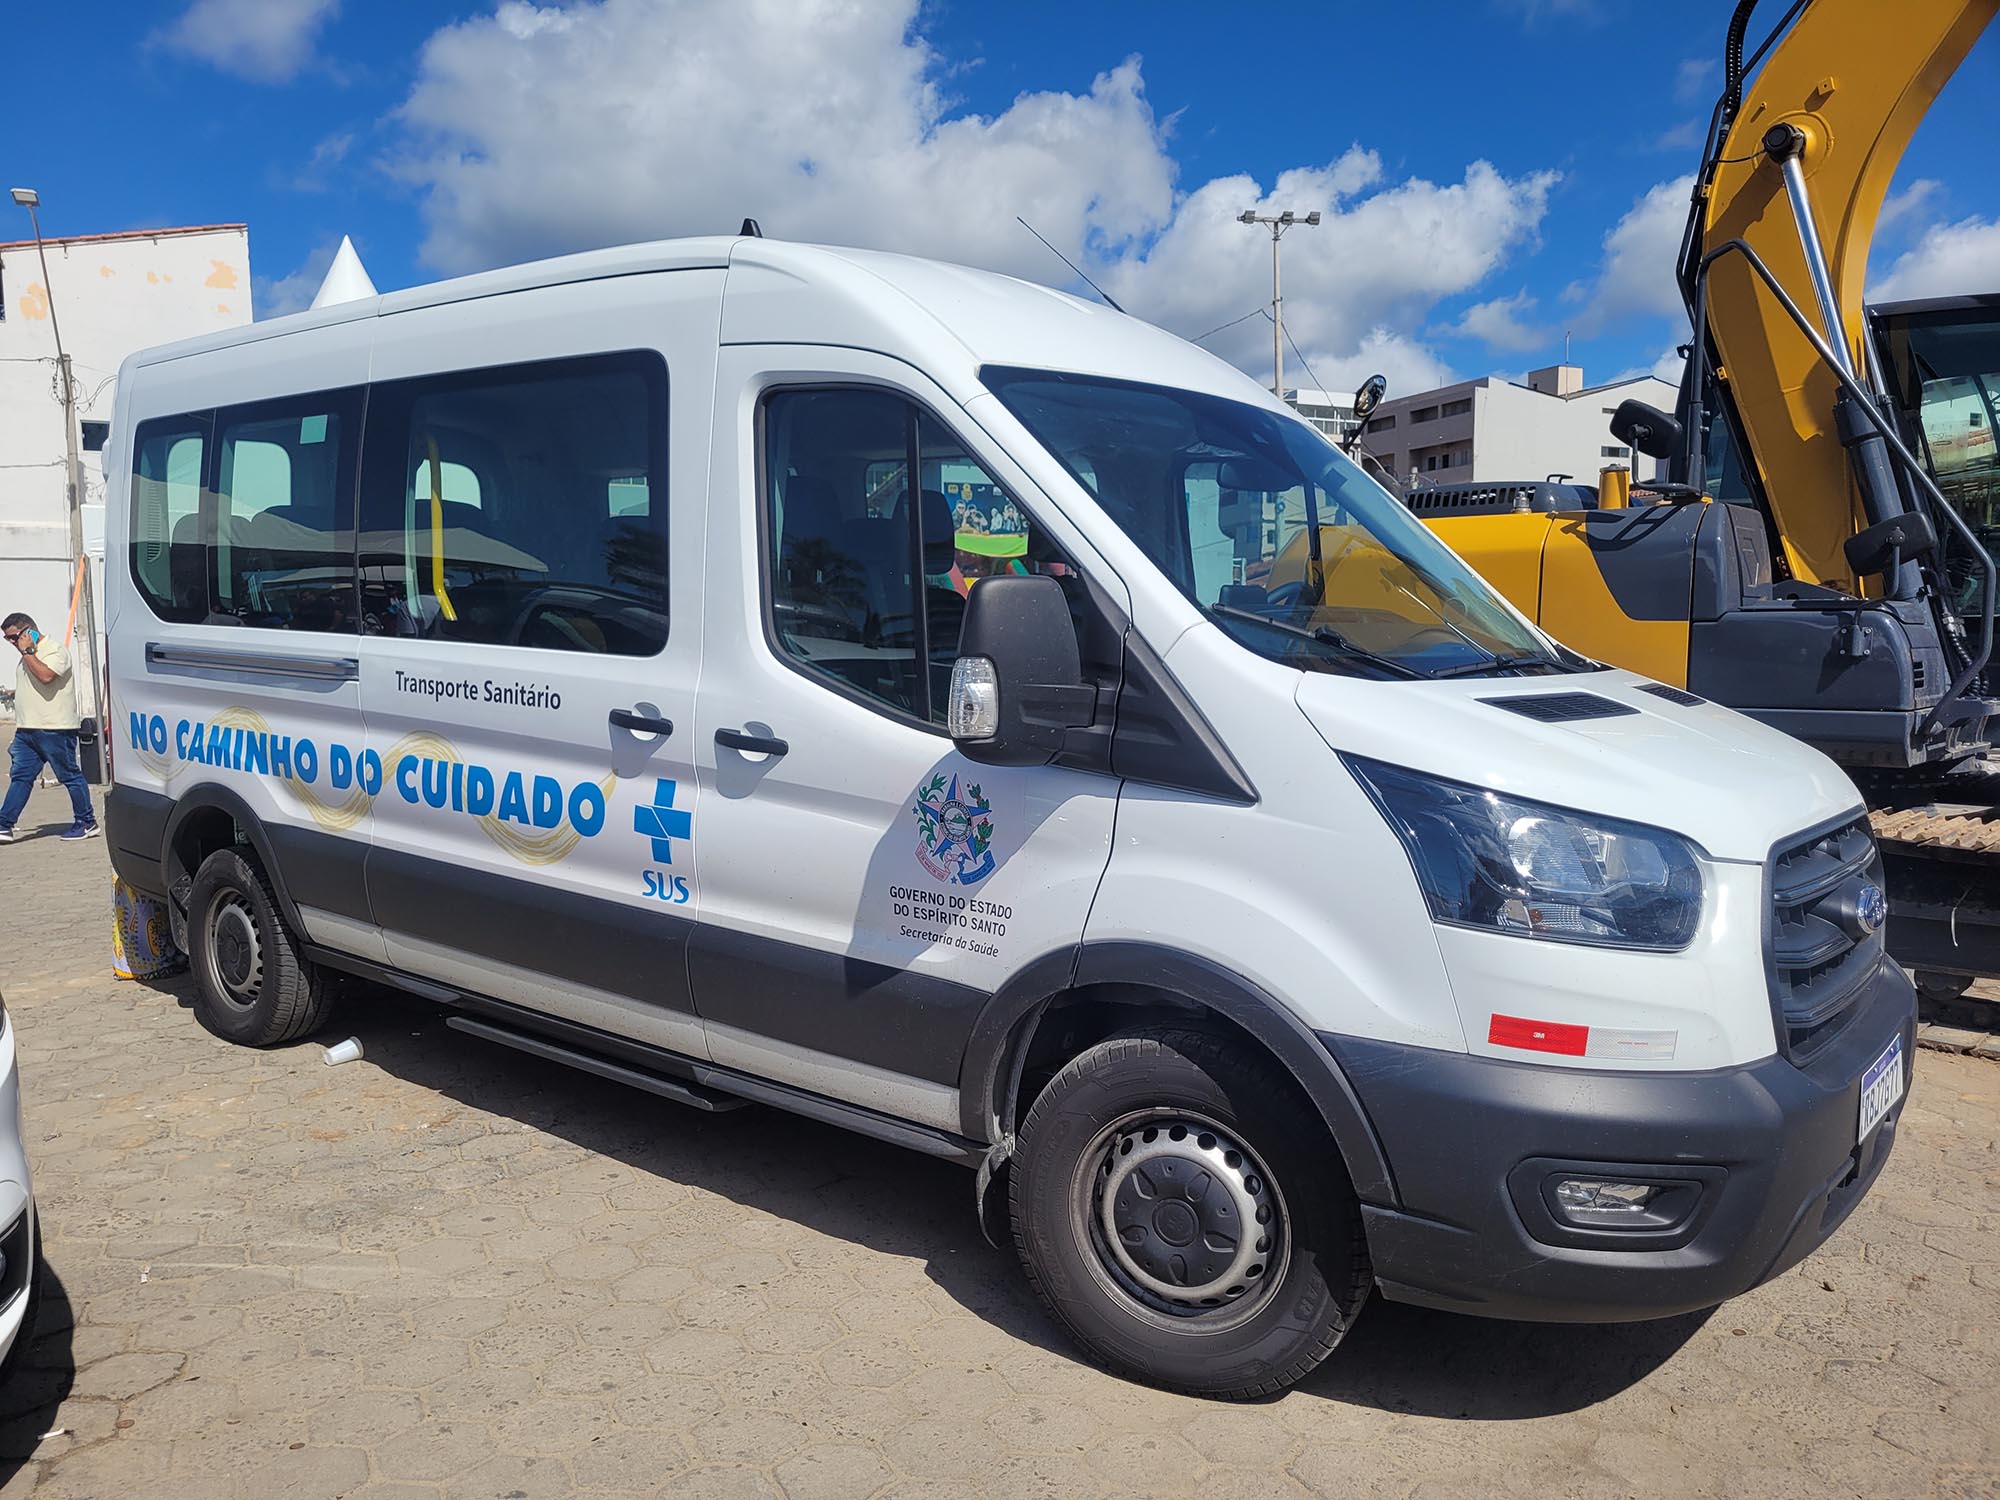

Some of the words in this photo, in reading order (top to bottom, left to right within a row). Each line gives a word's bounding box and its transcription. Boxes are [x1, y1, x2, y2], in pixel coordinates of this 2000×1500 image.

[395, 670, 479, 702] Transporte
[483, 680, 561, 710] Sanitário
[130, 711, 168, 756] NO
[176, 718, 318, 784] CAMINHO
[330, 743, 383, 796] DO
[396, 754, 606, 838] CUIDADO
[642, 869, 690, 904] SUS
[890, 885, 945, 907] GOVERNO
[949, 896, 966, 910] DO
[970, 899, 1012, 920] ESTADO
[893, 903, 909, 917] DO
[913, 906, 967, 929] ESPÍRITO
[971, 917, 1006, 937] SANTO
[899, 924, 952, 945] Secretaria
[955, 936, 967, 949] da
[968, 939, 999, 958] Saúde
